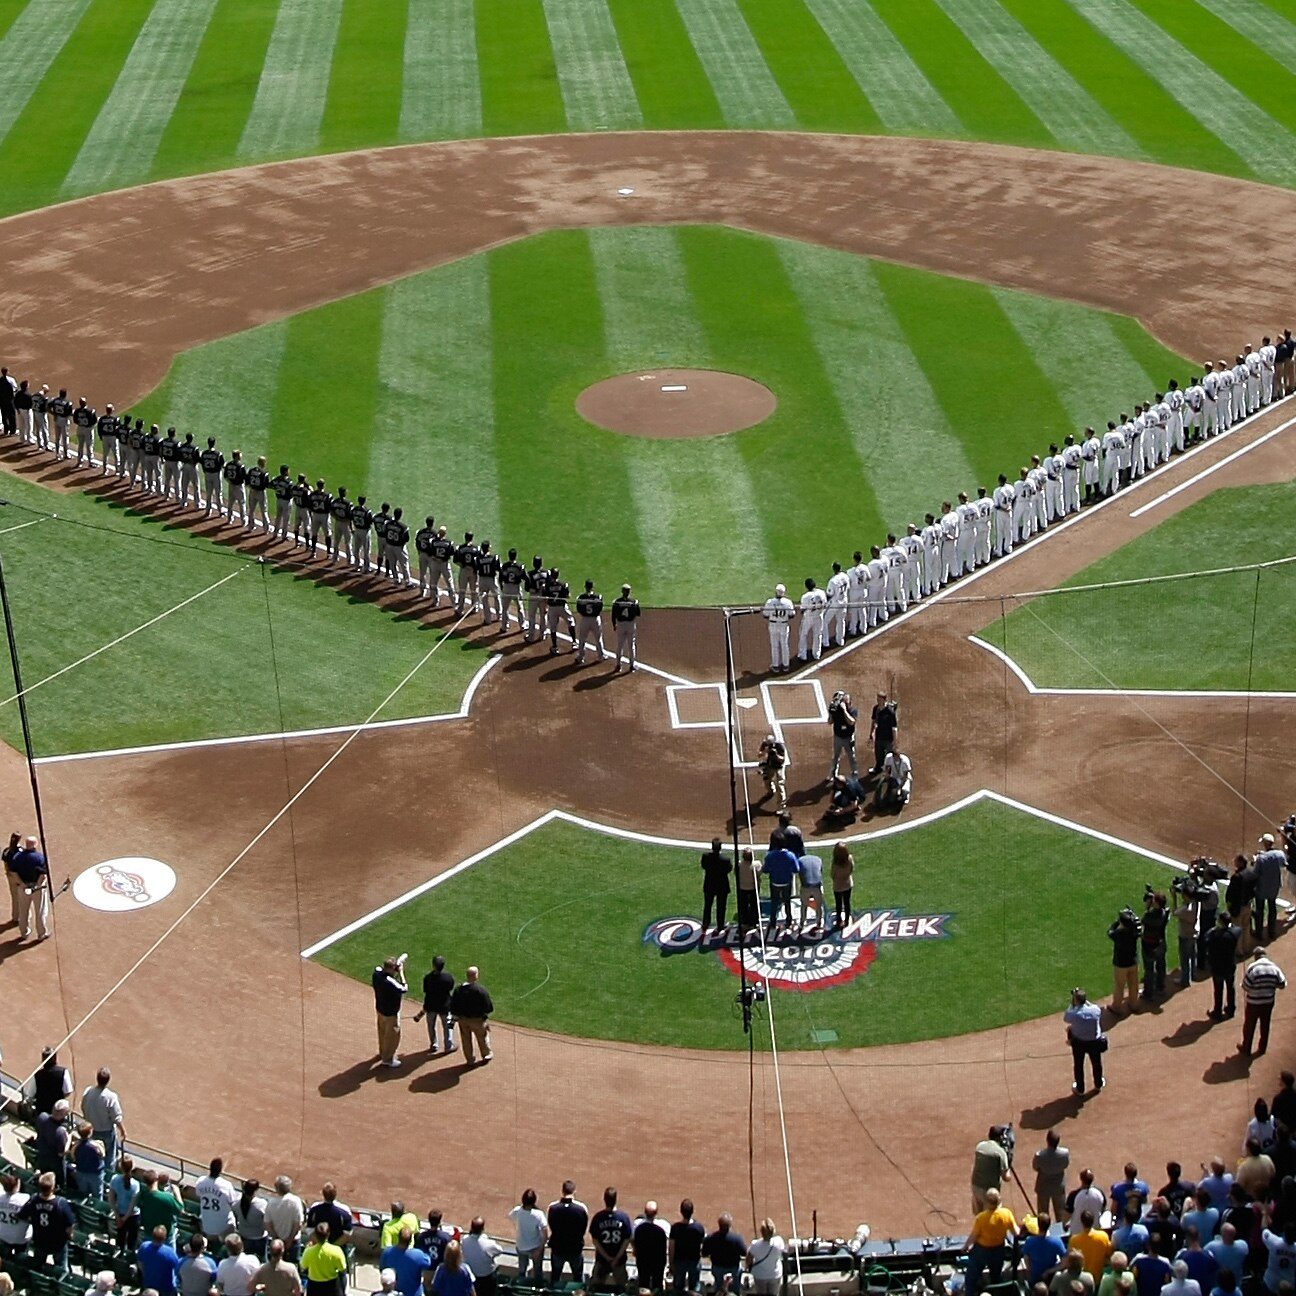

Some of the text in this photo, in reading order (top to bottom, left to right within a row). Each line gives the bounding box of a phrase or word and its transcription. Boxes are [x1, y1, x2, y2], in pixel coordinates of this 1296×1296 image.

[764, 943, 836, 960] 2010
[201, 1196, 220, 1212] 28
[39, 1212, 49, 1227] 8
[601, 1231, 621, 1244] 28
[429, 1246, 438, 1260] 8
